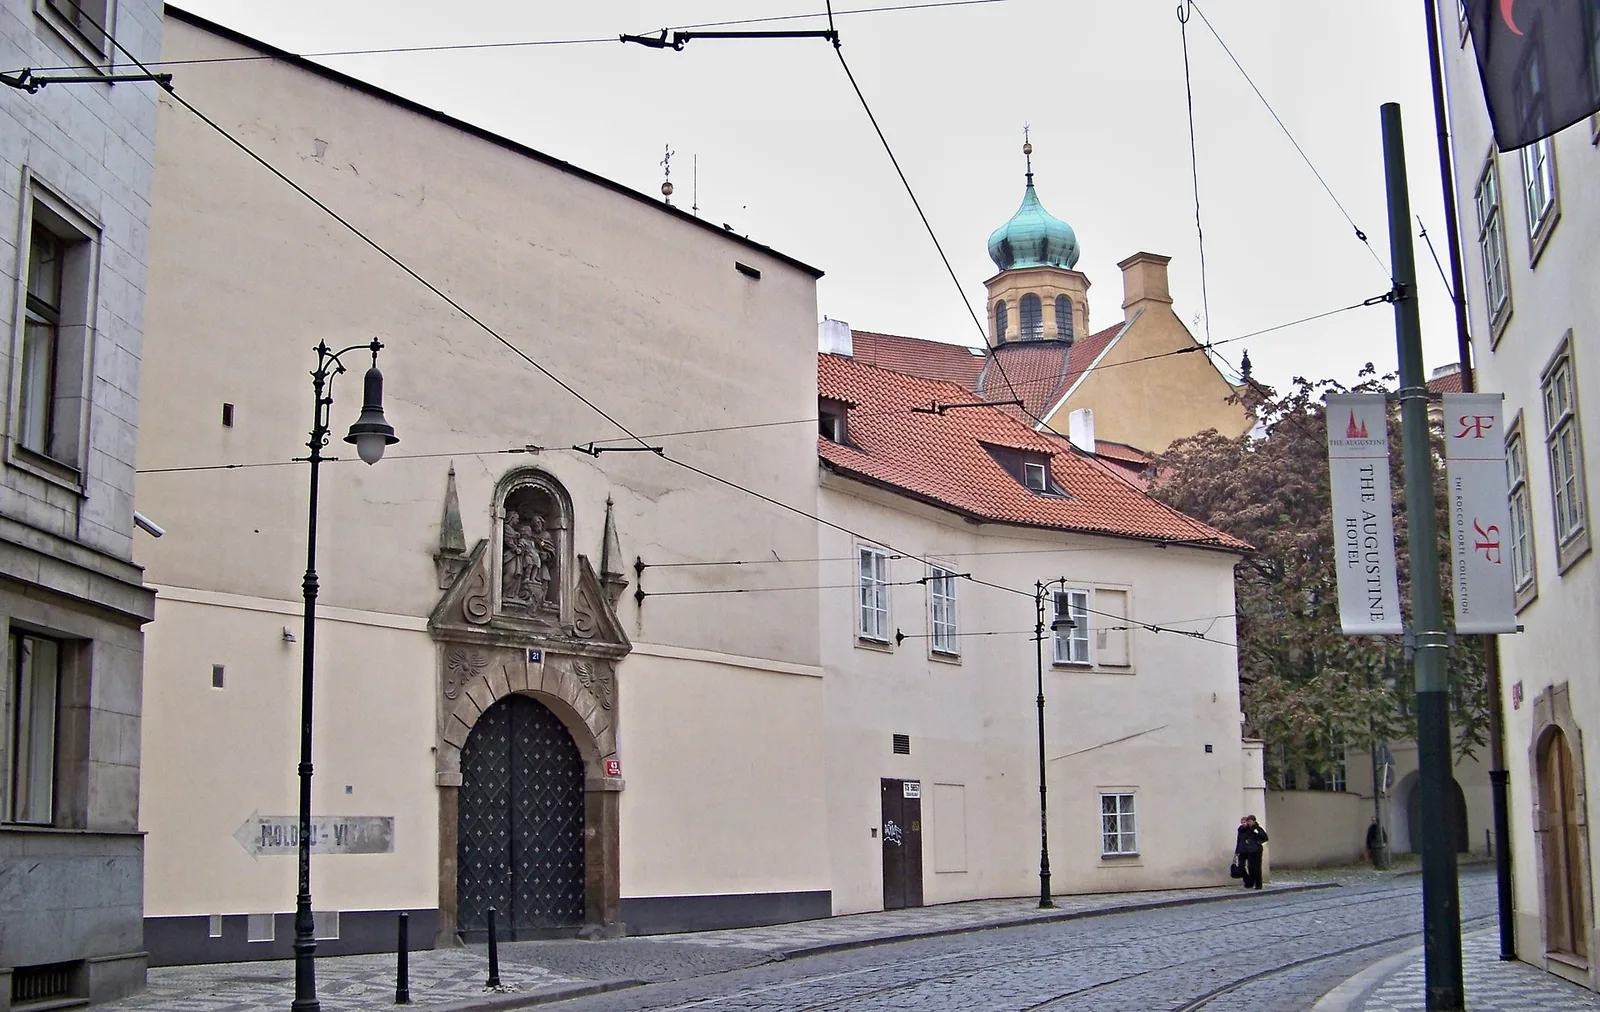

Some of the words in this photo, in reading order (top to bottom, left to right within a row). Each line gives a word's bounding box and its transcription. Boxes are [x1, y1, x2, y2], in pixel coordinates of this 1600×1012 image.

[1359, 464, 1375, 503] THE
[1456, 495, 1464, 526] ROCCO
[1346, 518, 1359, 569] HOTEL
[1458, 530, 1466, 555] FORTE
[1361, 510, 1385, 622] AUGUSTINE
[1459, 559, 1469, 615] COLLECTION
[532, 652, 540, 660] 21
[261, 824, 317, 847] MOLDU
